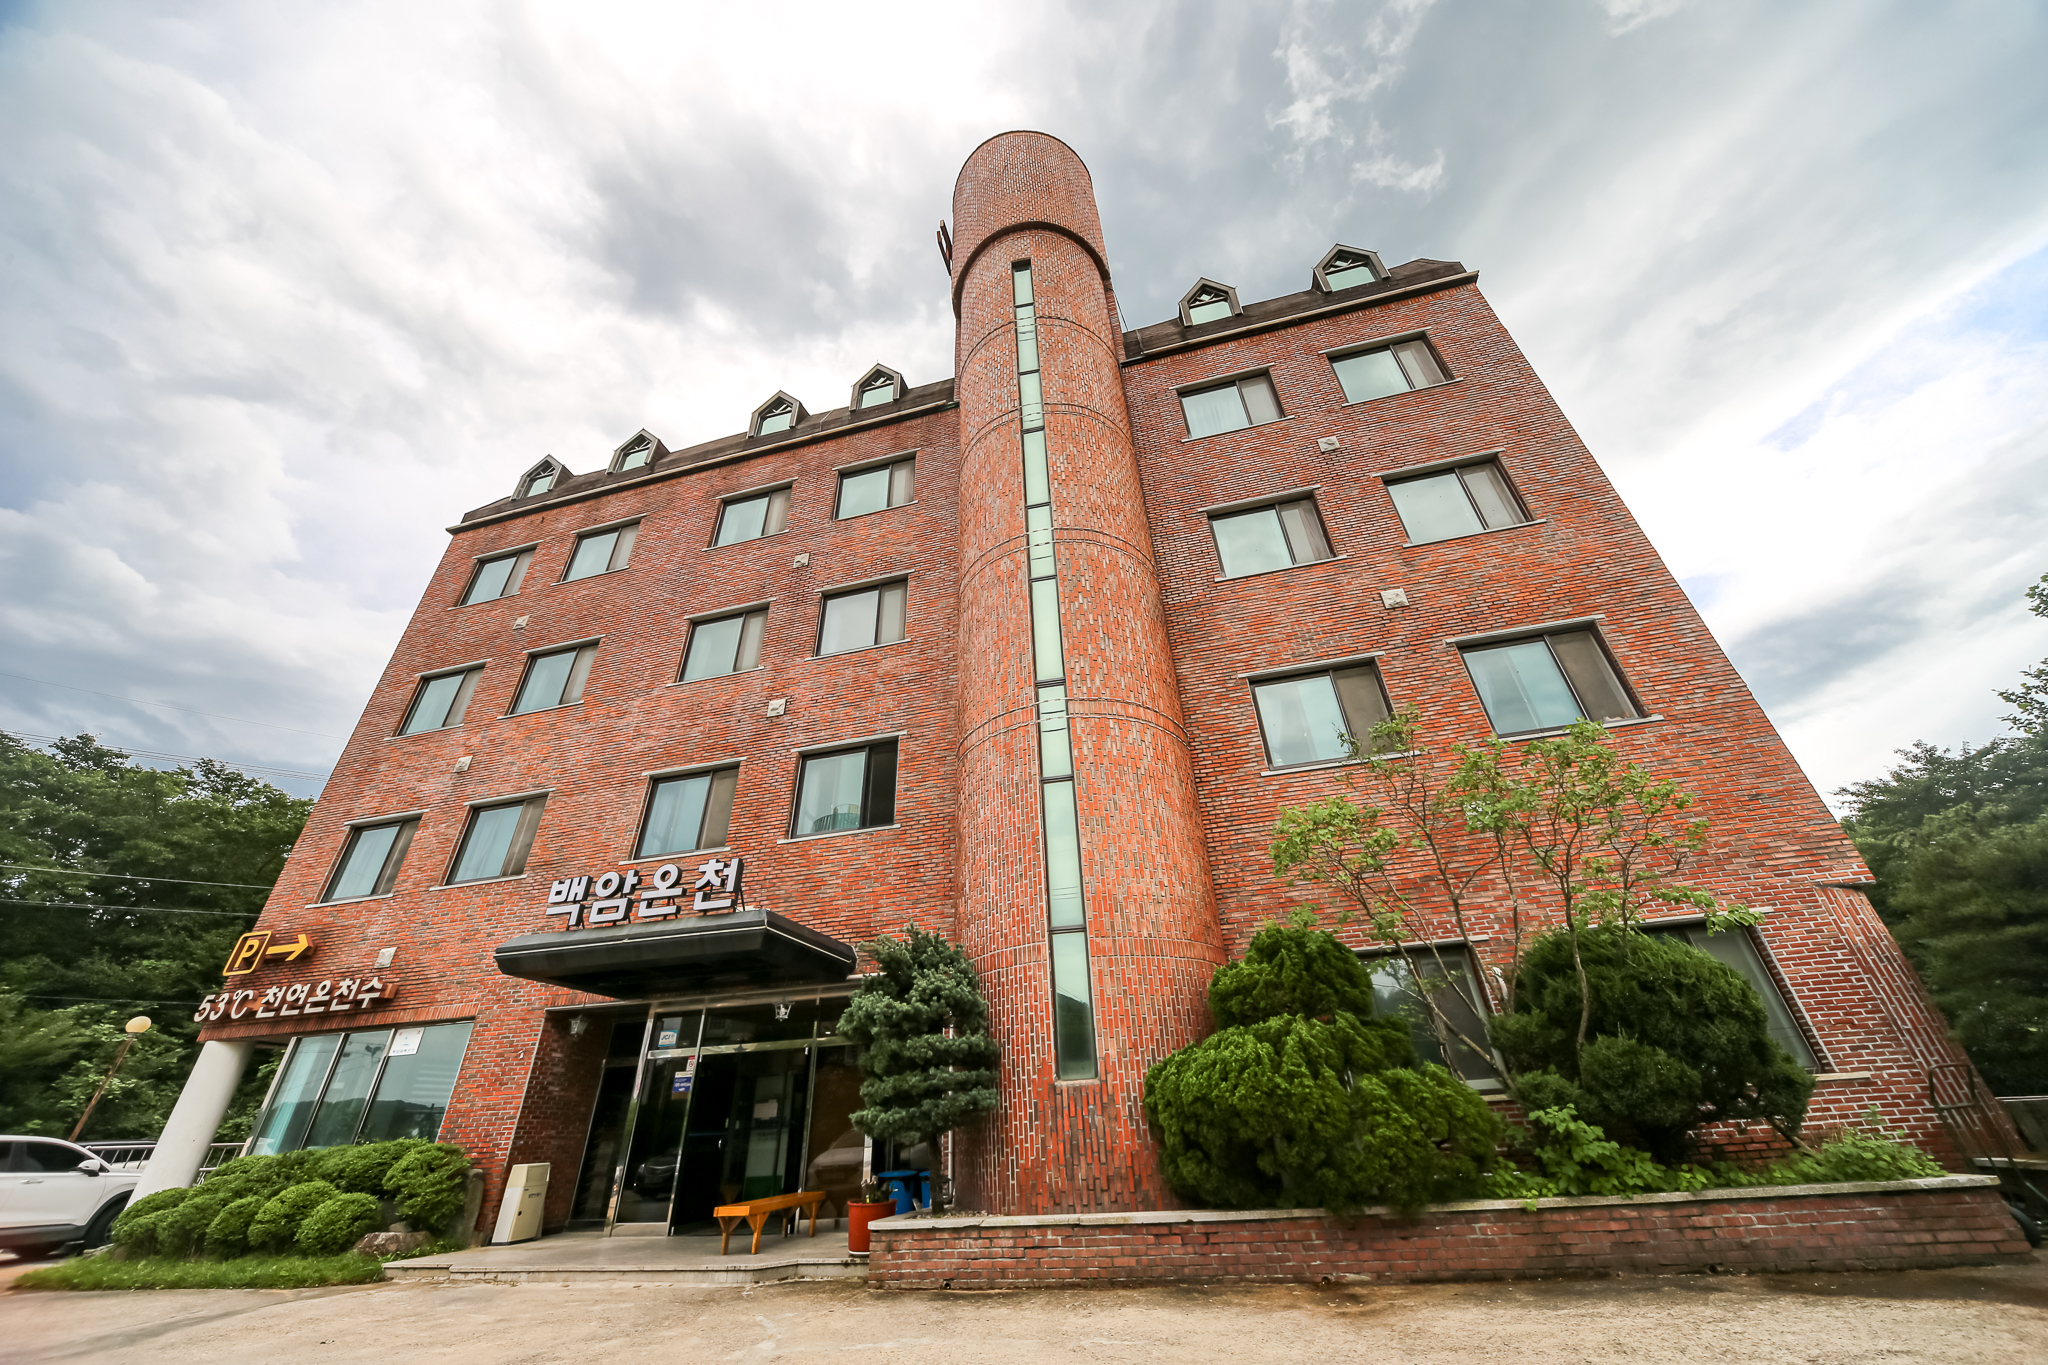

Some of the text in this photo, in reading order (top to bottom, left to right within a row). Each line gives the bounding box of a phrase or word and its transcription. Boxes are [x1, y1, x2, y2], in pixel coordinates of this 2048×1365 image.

[545, 858, 741, 926] 백암온천
[233, 939, 259, 968] P
[255, 976, 385, 1018] 천연온천수
